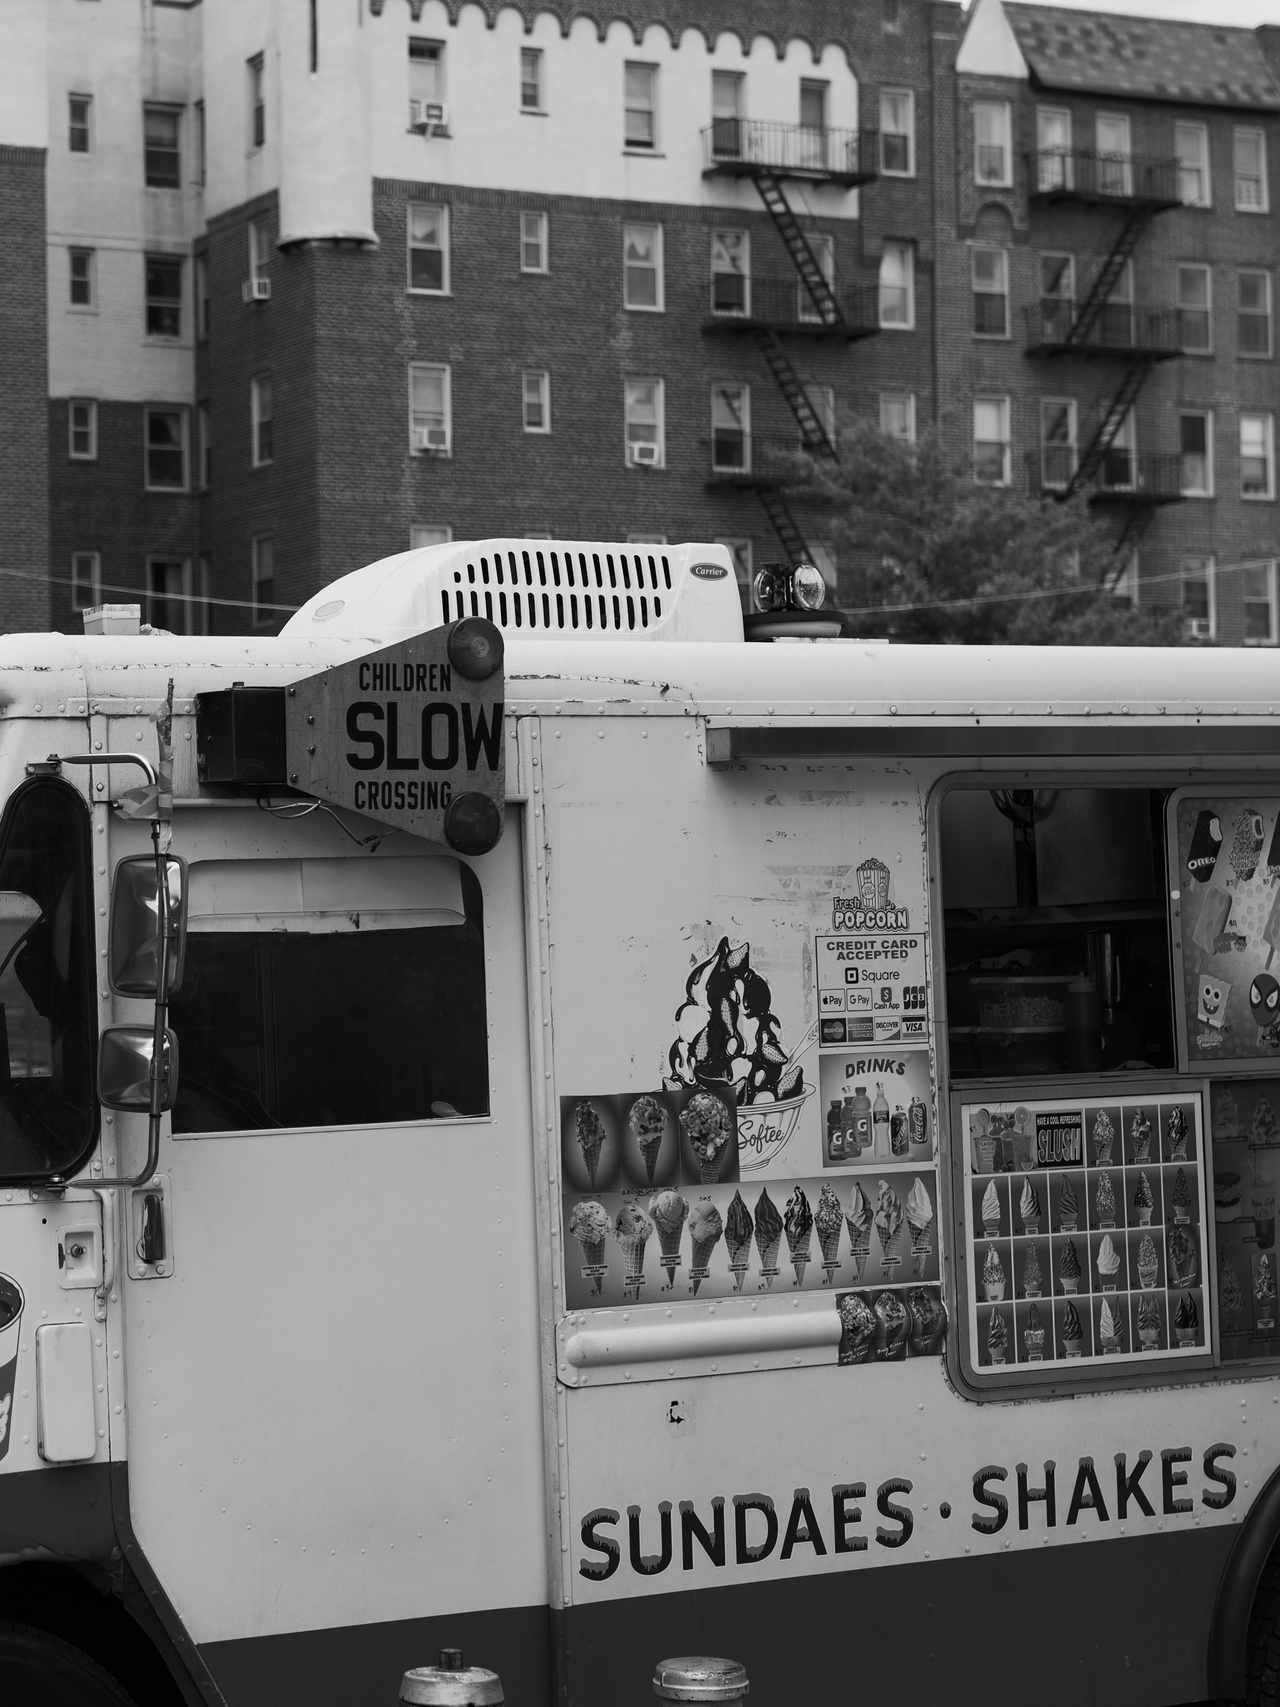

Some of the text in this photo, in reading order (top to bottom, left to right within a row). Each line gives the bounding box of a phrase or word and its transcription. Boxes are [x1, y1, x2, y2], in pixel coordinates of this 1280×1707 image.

[695, 566, 723, 576] Carrier
[359, 662, 451, 692] CHILDREN
[346, 701, 504, 771] SLOW
[354, 780, 452, 811] CROSSING
[1188, 856, 1216, 870] OREO
[834, 897, 861, 909] Fresh
[834, 909, 908, 930] POPCORN
[826, 939, 918, 951] CREDIT CARD
[836, 950, 908, 960] ACCEPTED
[861, 969, 900, 983] Square
[829, 996, 842, 1006] Pay
[857, 994, 869, 1006] Pay
[874, 1002, 900, 1010] Cash App
[876, 1021, 899, 1029] DISCOVER
[905, 1022, 923, 1032] VISA
[845, 1058, 906, 1079] DRINKS
[857, 1119, 867, 1131] G
[738, 1120, 784, 1154] Softee
[832, 1132, 842, 1144] G
[1037, 1127, 1081, 1163] SLUSH
[578, 1441, 1237, 1582] SUNDAES SHAKES
